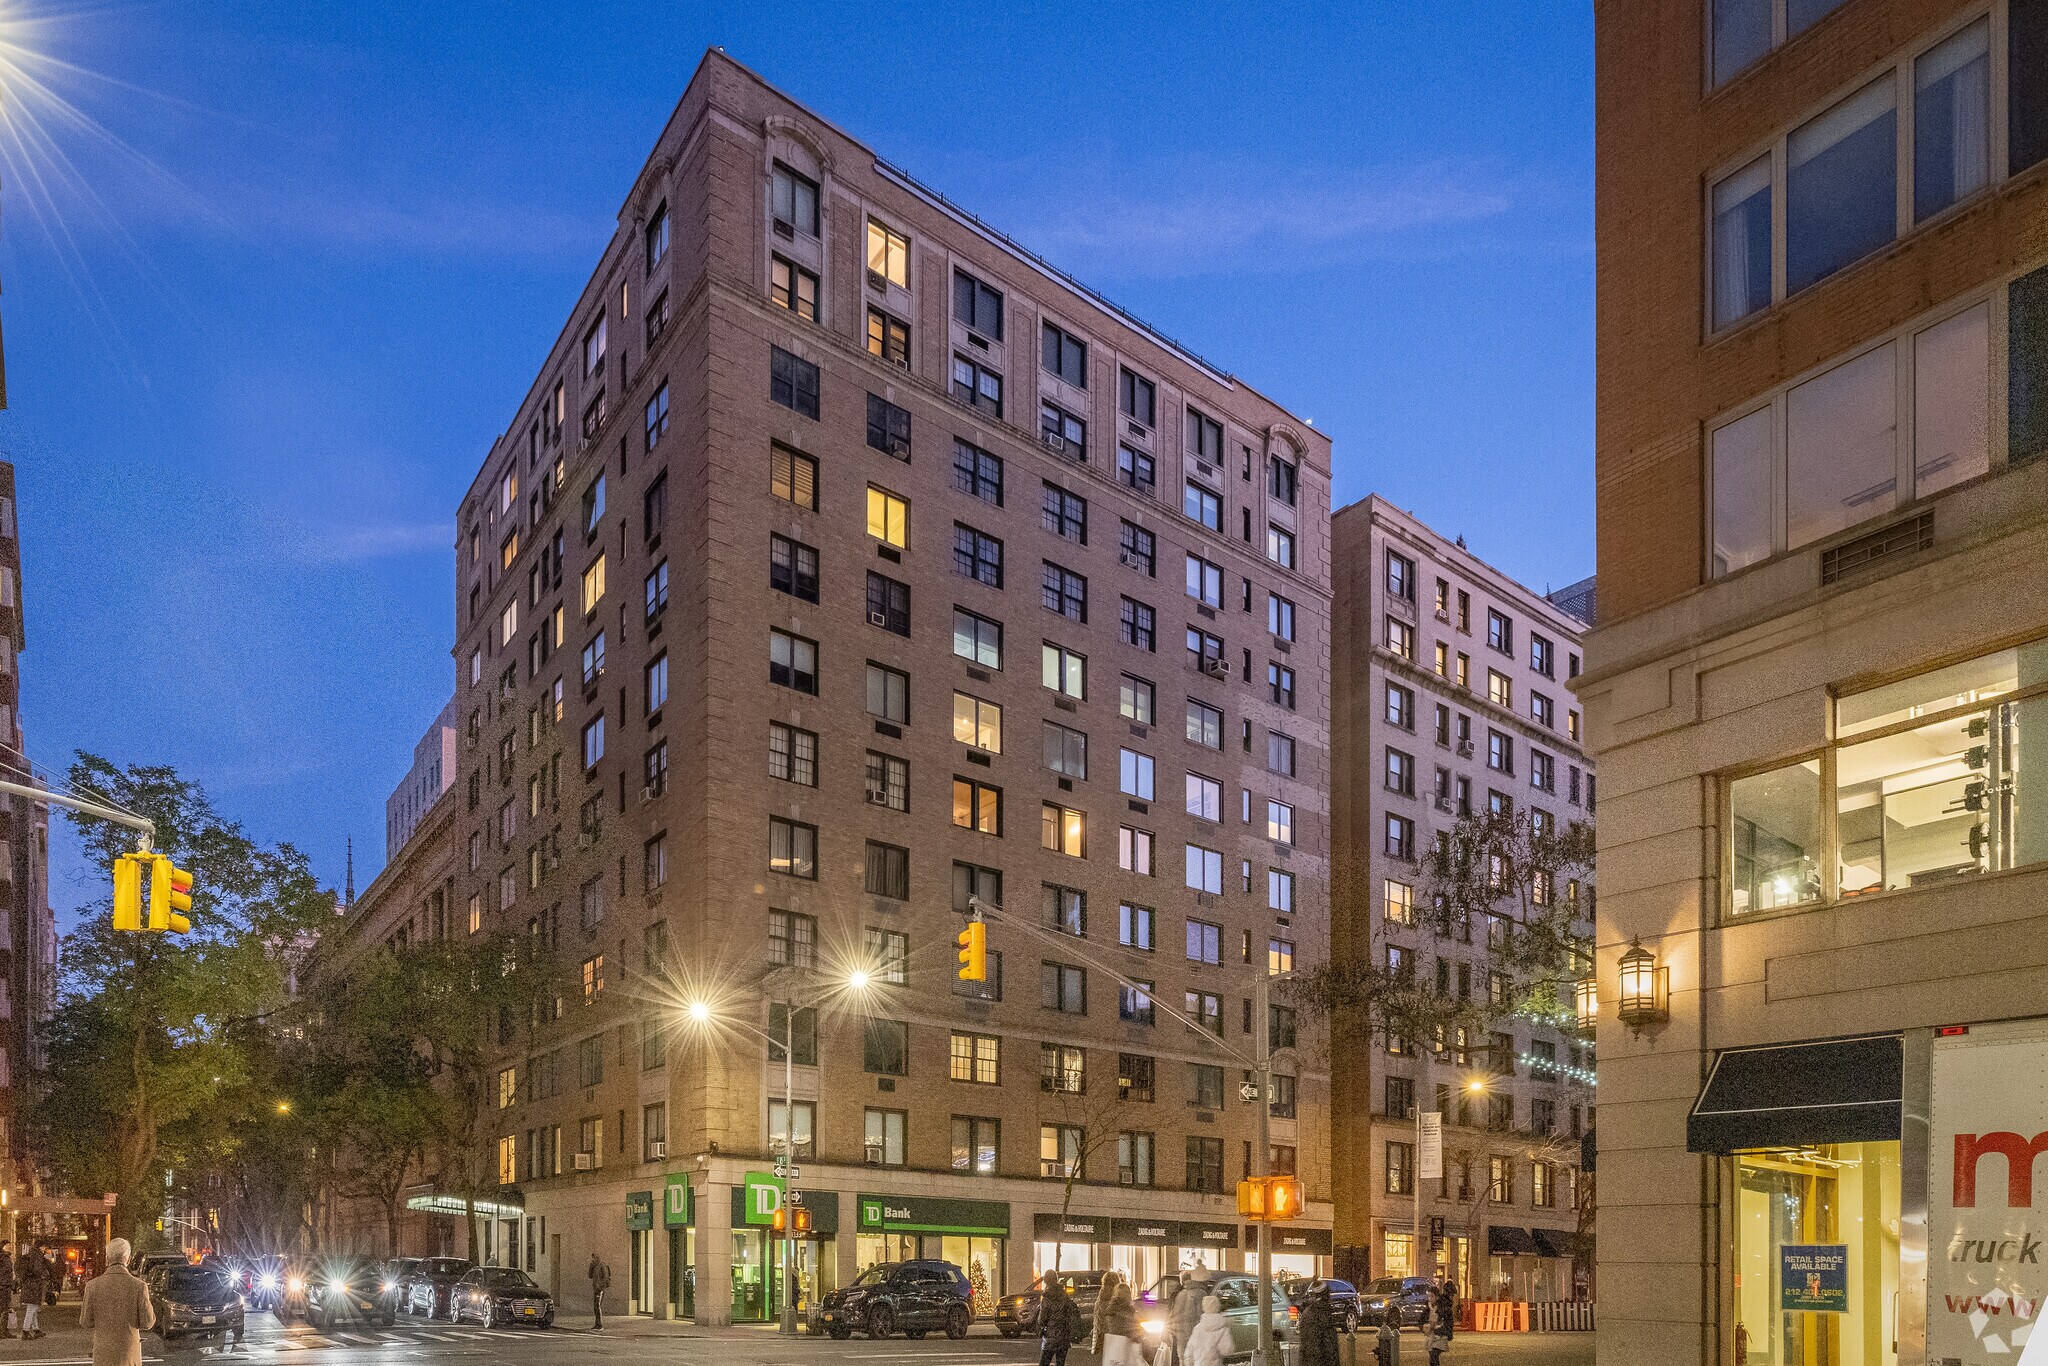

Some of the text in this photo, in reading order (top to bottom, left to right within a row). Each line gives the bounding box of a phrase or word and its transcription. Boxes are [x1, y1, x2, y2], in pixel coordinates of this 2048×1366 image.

[750, 1183, 781, 1215] TD
[865, 1206, 911, 1221] TD Bank
[1948, 1231, 2042, 1264] ruck
[1791, 1263, 1837, 1271] AVAILABLE
[1814, 1256, 1843, 1264] SPACE
